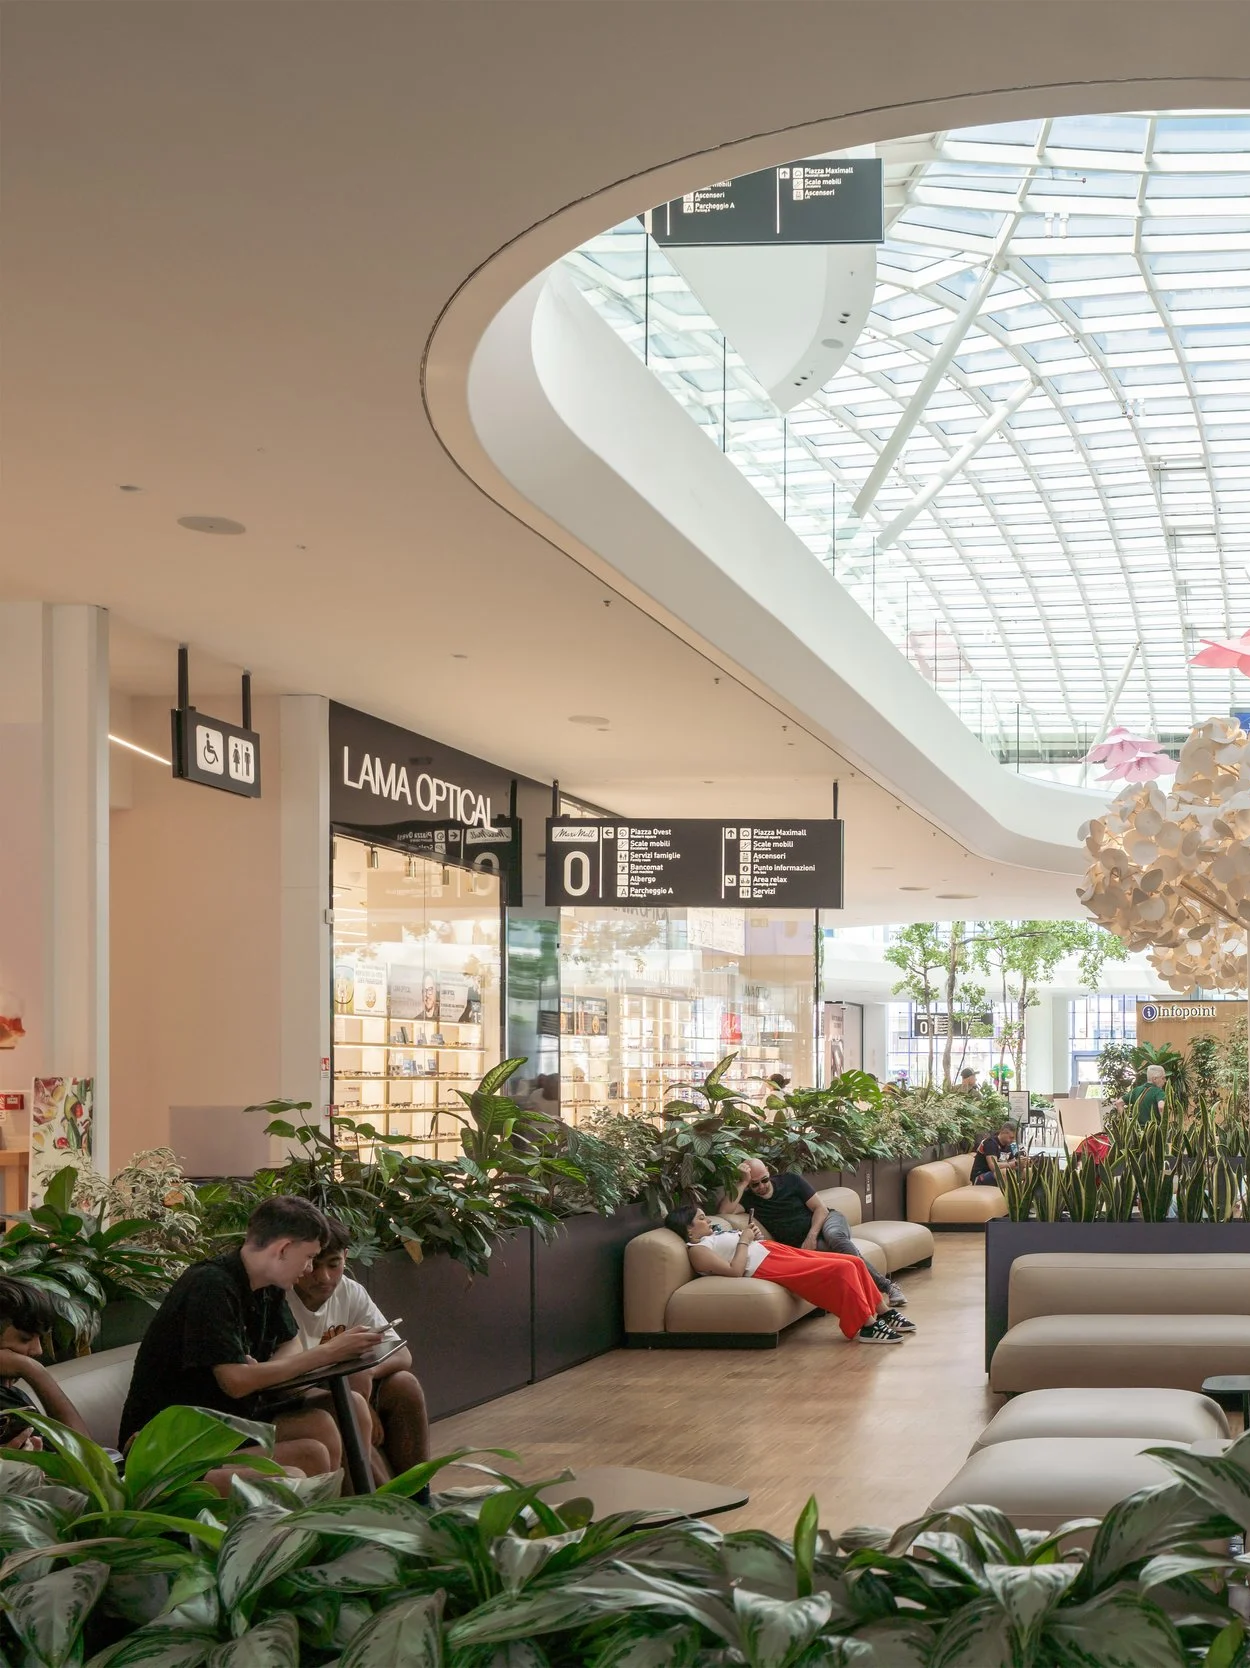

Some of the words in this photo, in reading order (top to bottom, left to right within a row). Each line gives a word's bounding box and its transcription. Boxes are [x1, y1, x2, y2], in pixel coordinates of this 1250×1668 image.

[343, 745, 412, 806] LAMA
[416, 773, 499, 833] OPTICAL
[654, 852, 681, 860] famiglie
[630, 863, 664, 871] Bancomat
[564, 851, 590, 897] 0
[630, 875, 656, 884] Albergo
[630, 887, 667, 895] Parcheggio
[1157, 1005, 1216, 1019] Infopoint
[920, 1021, 928, 1034] 0
